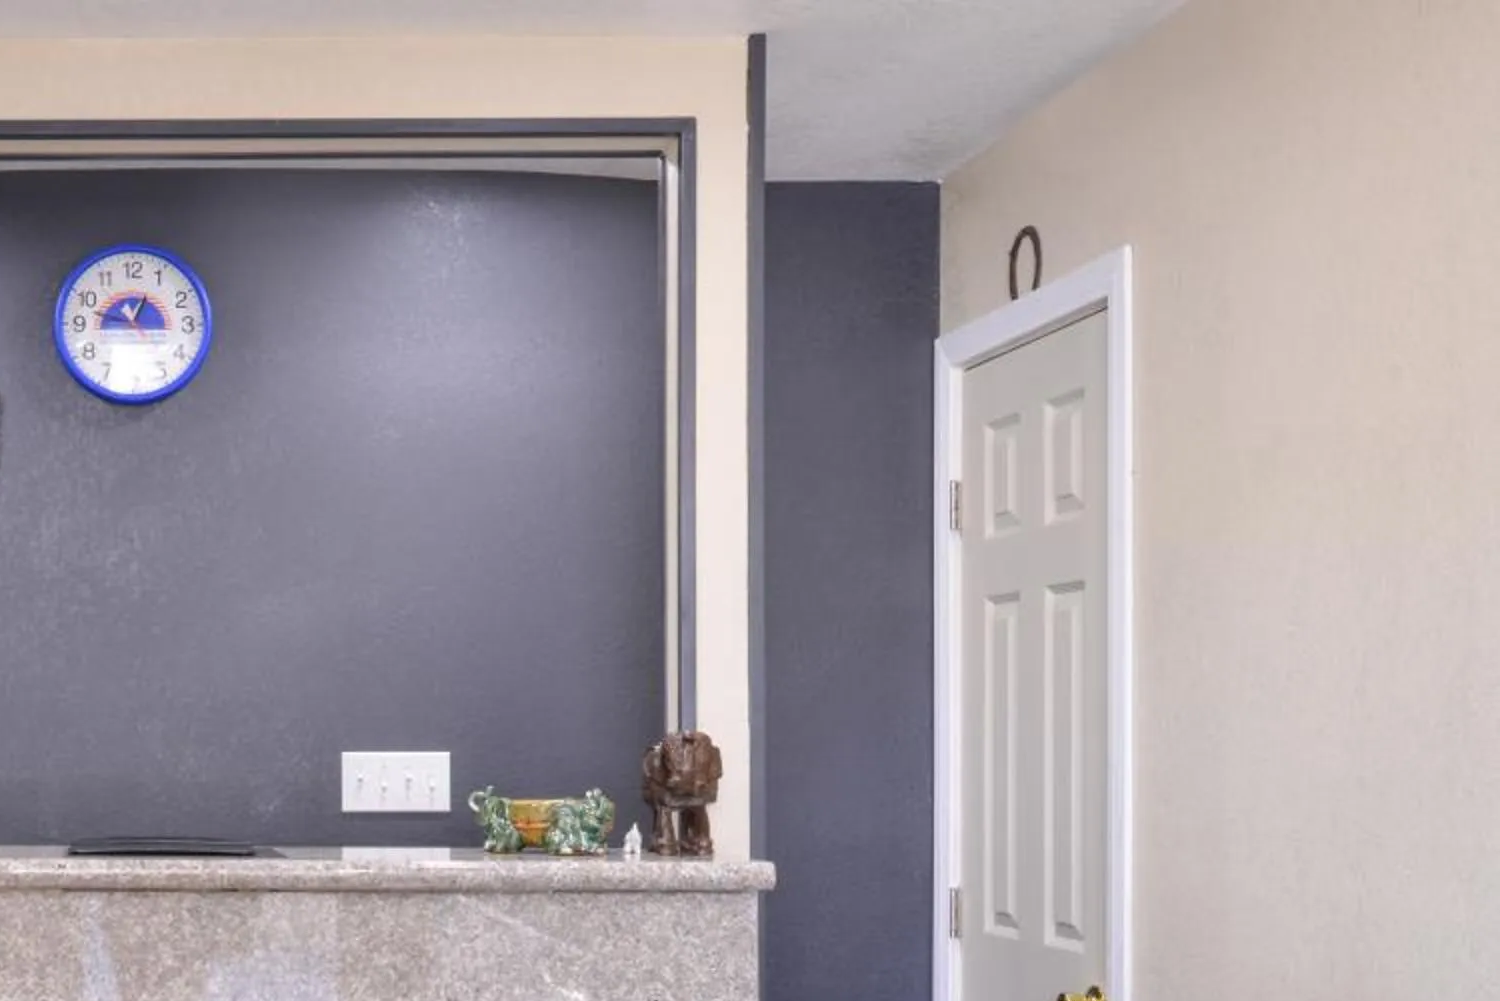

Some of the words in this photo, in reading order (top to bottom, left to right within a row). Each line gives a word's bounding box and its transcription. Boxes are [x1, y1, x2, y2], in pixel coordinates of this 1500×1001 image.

[98, 271, 113, 287] 11
[123, 261, 143, 279] 12
[155, 270, 162, 286] 1
[77, 291, 97, 308] 10
[175, 291, 188, 309] 2
[72, 315, 86, 333] 9
[181, 315, 195, 333] 3
[82, 342, 96, 360] 8
[173, 344, 185, 360] 4
[101, 362, 112, 380] 7
